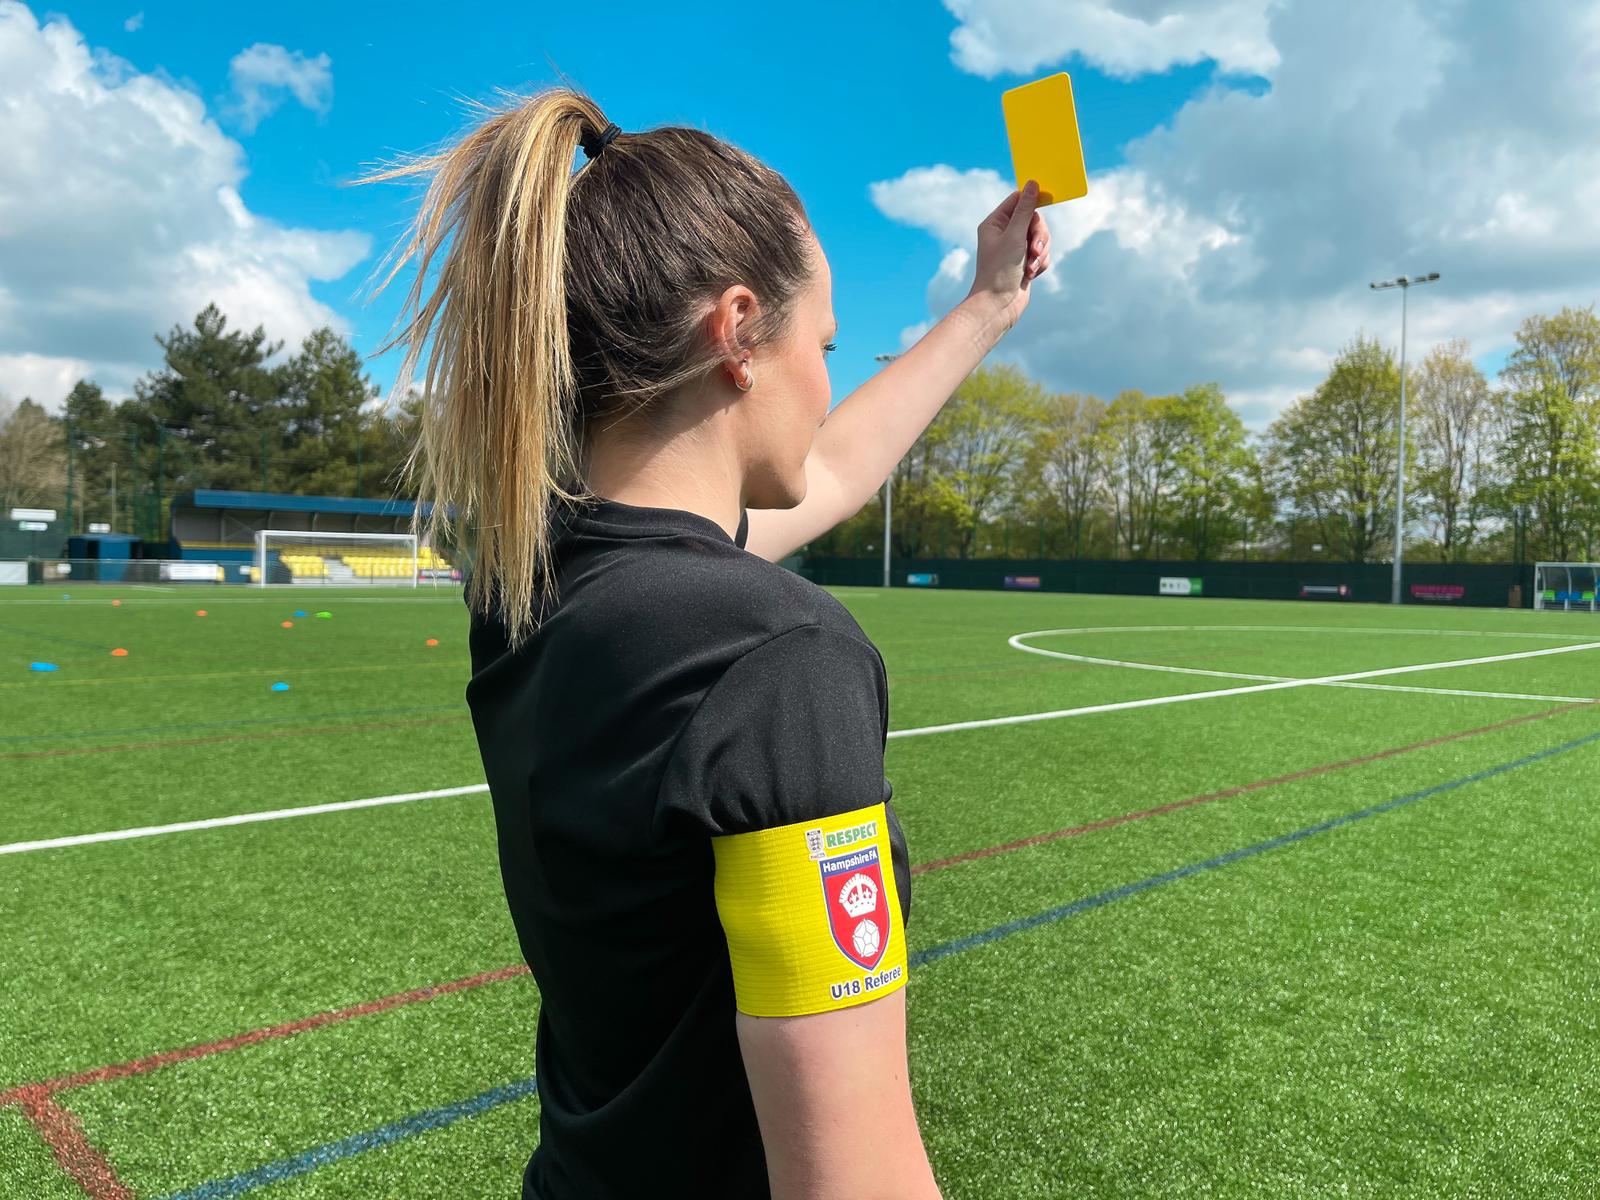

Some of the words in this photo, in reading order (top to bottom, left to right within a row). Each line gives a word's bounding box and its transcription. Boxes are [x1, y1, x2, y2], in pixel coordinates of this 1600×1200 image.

[826, 822, 877, 848] RESPECT
[831, 980, 861, 999] U18
[864, 966, 901, 991] Referee
